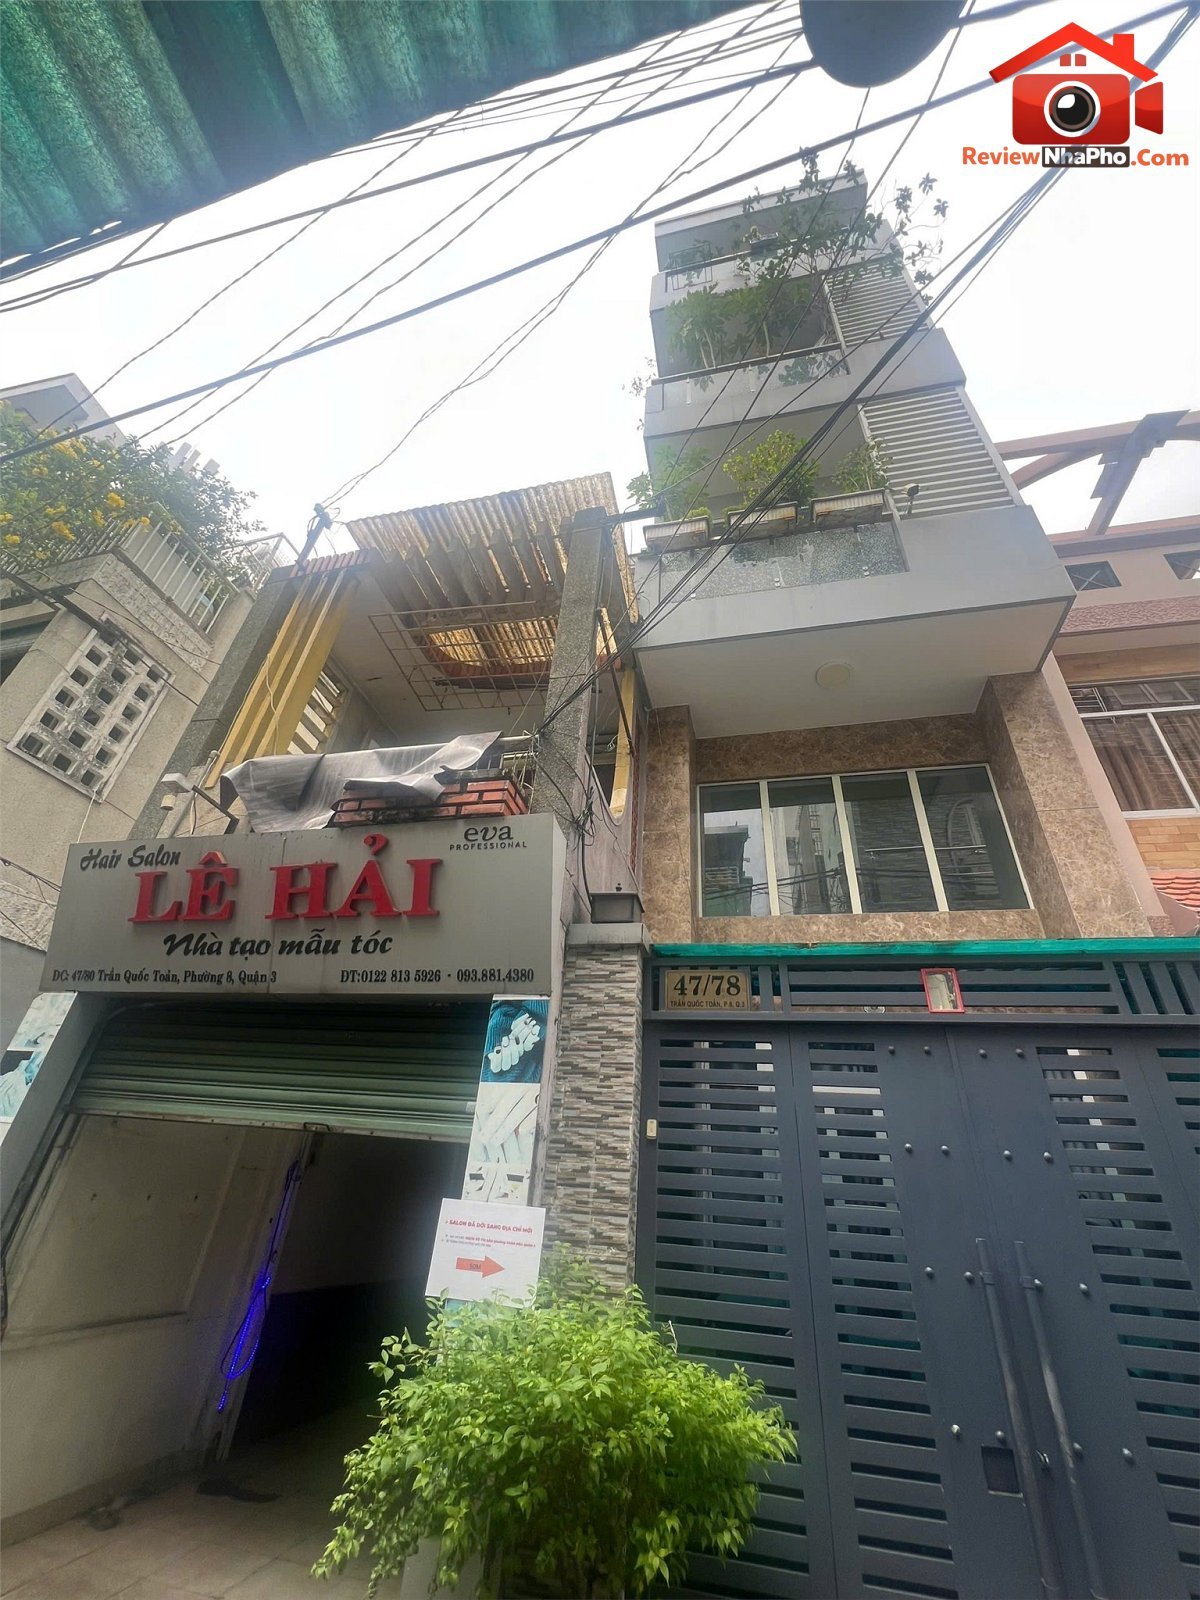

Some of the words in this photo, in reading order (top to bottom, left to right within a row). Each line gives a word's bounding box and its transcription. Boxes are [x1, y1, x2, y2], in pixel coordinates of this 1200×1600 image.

[463, 825, 514, 842] eva
[449, 841, 528, 851] PROFESSIONAL
[80, 848, 122, 871] Hair
[127, 844, 181, 869] Salon
[127, 850, 239, 923] LÊ
[264, 833, 443, 920] HẢI
[163, 932, 224, 957] Nhà
[228, 936, 271, 961] tạo
[278, 928, 341, 956] mẫu
[350, 930, 393, 954] tóc
[71, 969, 96, 982] 47/80
[123, 968, 149, 984] Quốc
[152, 969, 180, 984] Toản,
[183, 970, 225, 985] Phường
[238, 970, 267, 985] Quận
[270, 970, 277, 983] 3
[390, 969, 410, 983] 813
[414, 969, 441, 983] 5926
[456, 969, 534, 983] 093.881.4380
[673, 974, 741, 996] 47/78
[687, 998, 704, 1008] QUỐC
